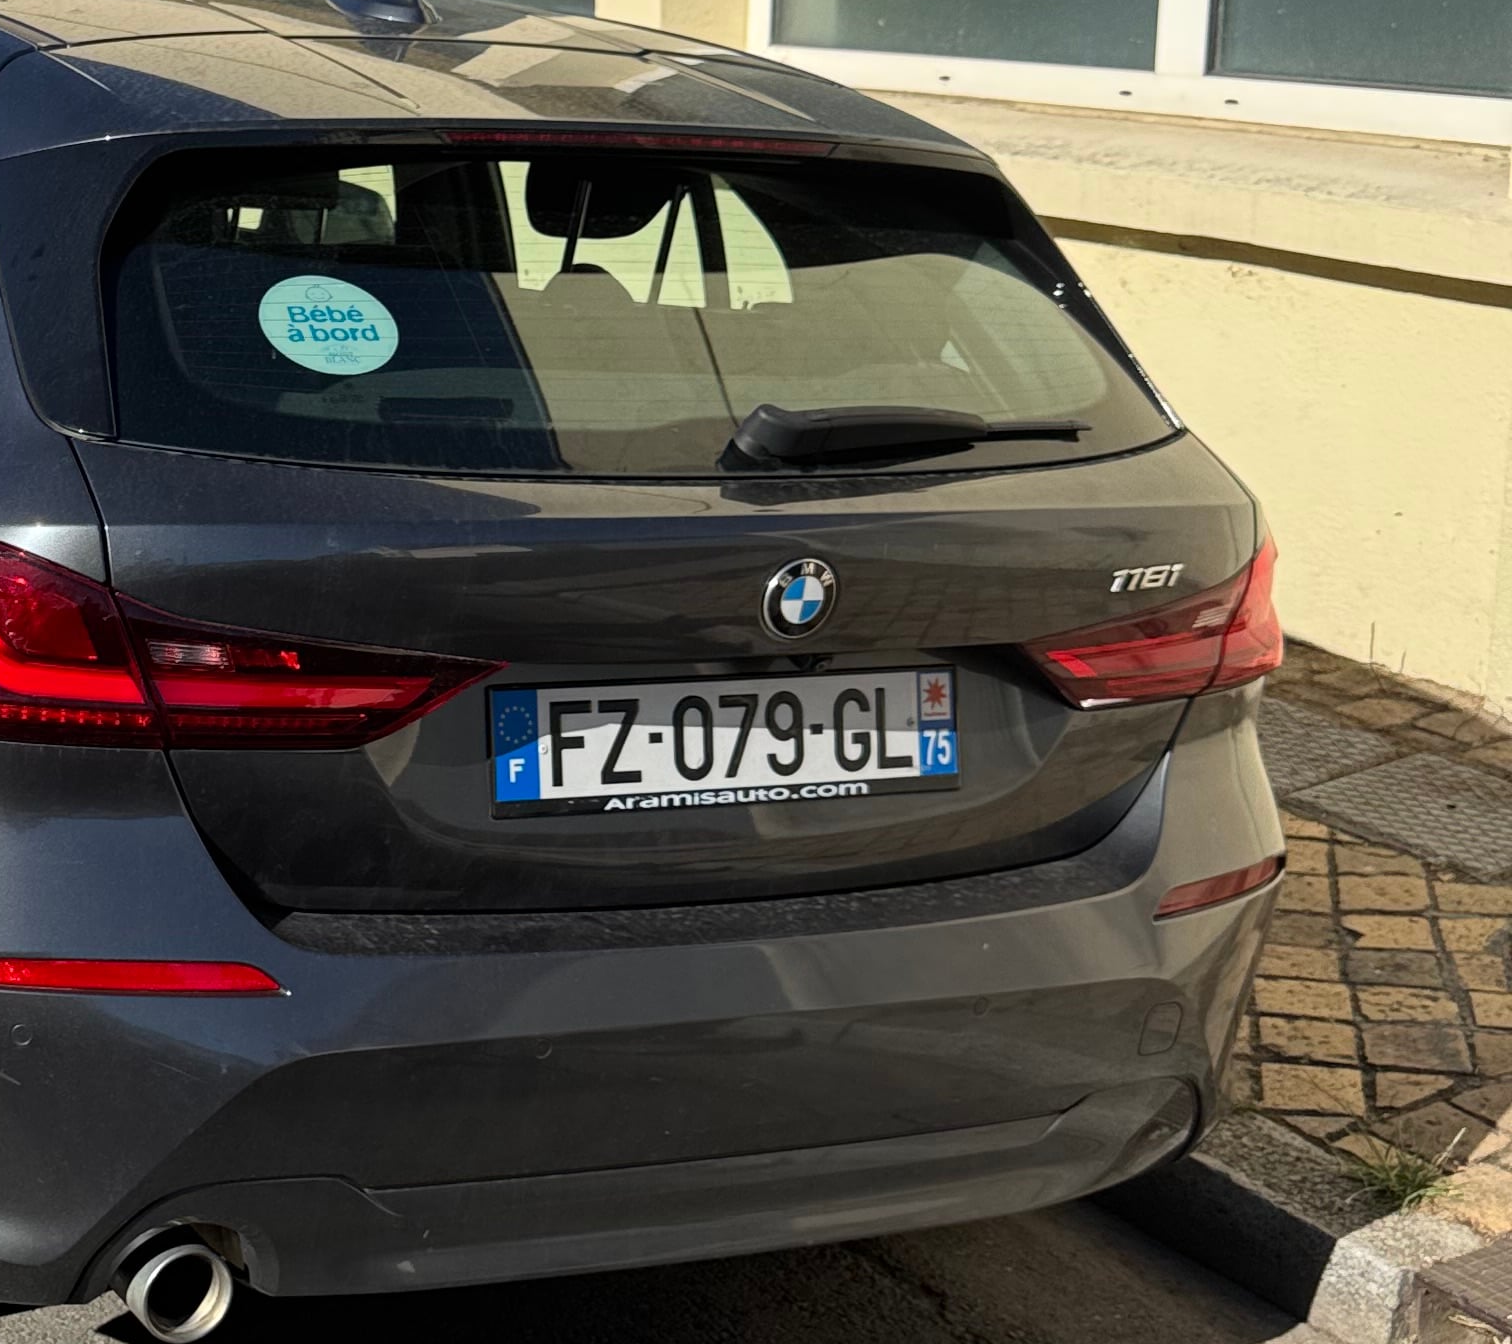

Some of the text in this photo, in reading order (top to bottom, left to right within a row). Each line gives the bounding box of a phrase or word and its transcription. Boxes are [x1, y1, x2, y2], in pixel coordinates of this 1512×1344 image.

[286, 305, 364, 323] Bébé
[287, 324, 380, 342] à bord
[1110, 563, 1185, 592] 118i
[509, 688, 952, 787] F FZ-079-GL 75
[604, 782, 869, 811] Aramisauto.com
